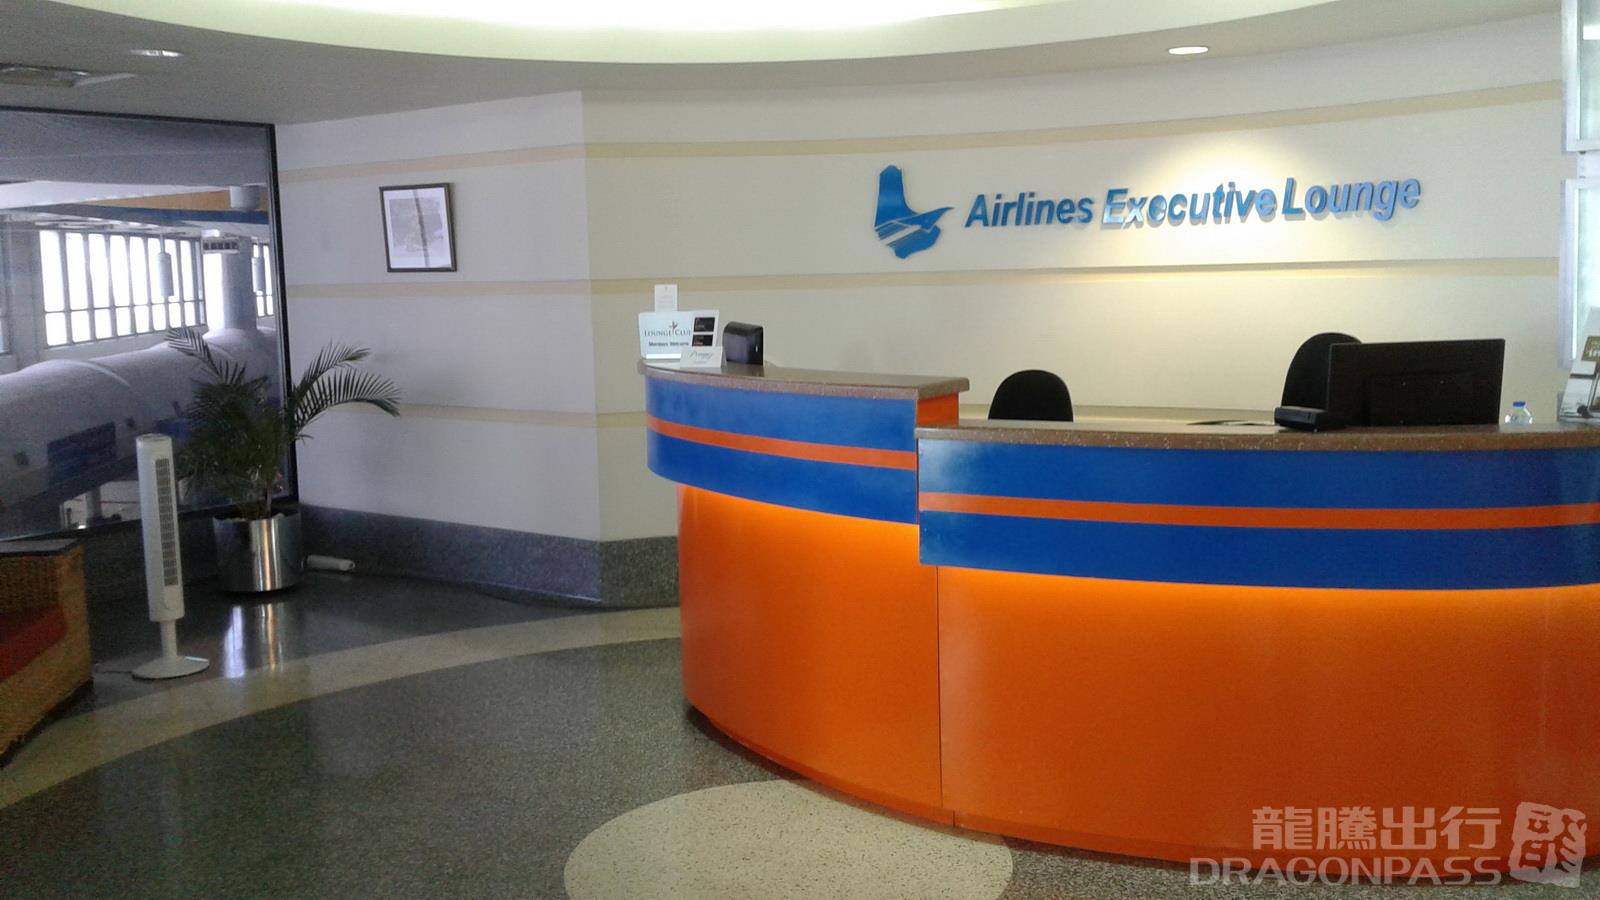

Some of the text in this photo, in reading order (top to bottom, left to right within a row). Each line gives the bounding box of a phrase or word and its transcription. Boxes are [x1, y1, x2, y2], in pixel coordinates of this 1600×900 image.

[965, 176, 1421, 228] Airlines Executive Lounge
